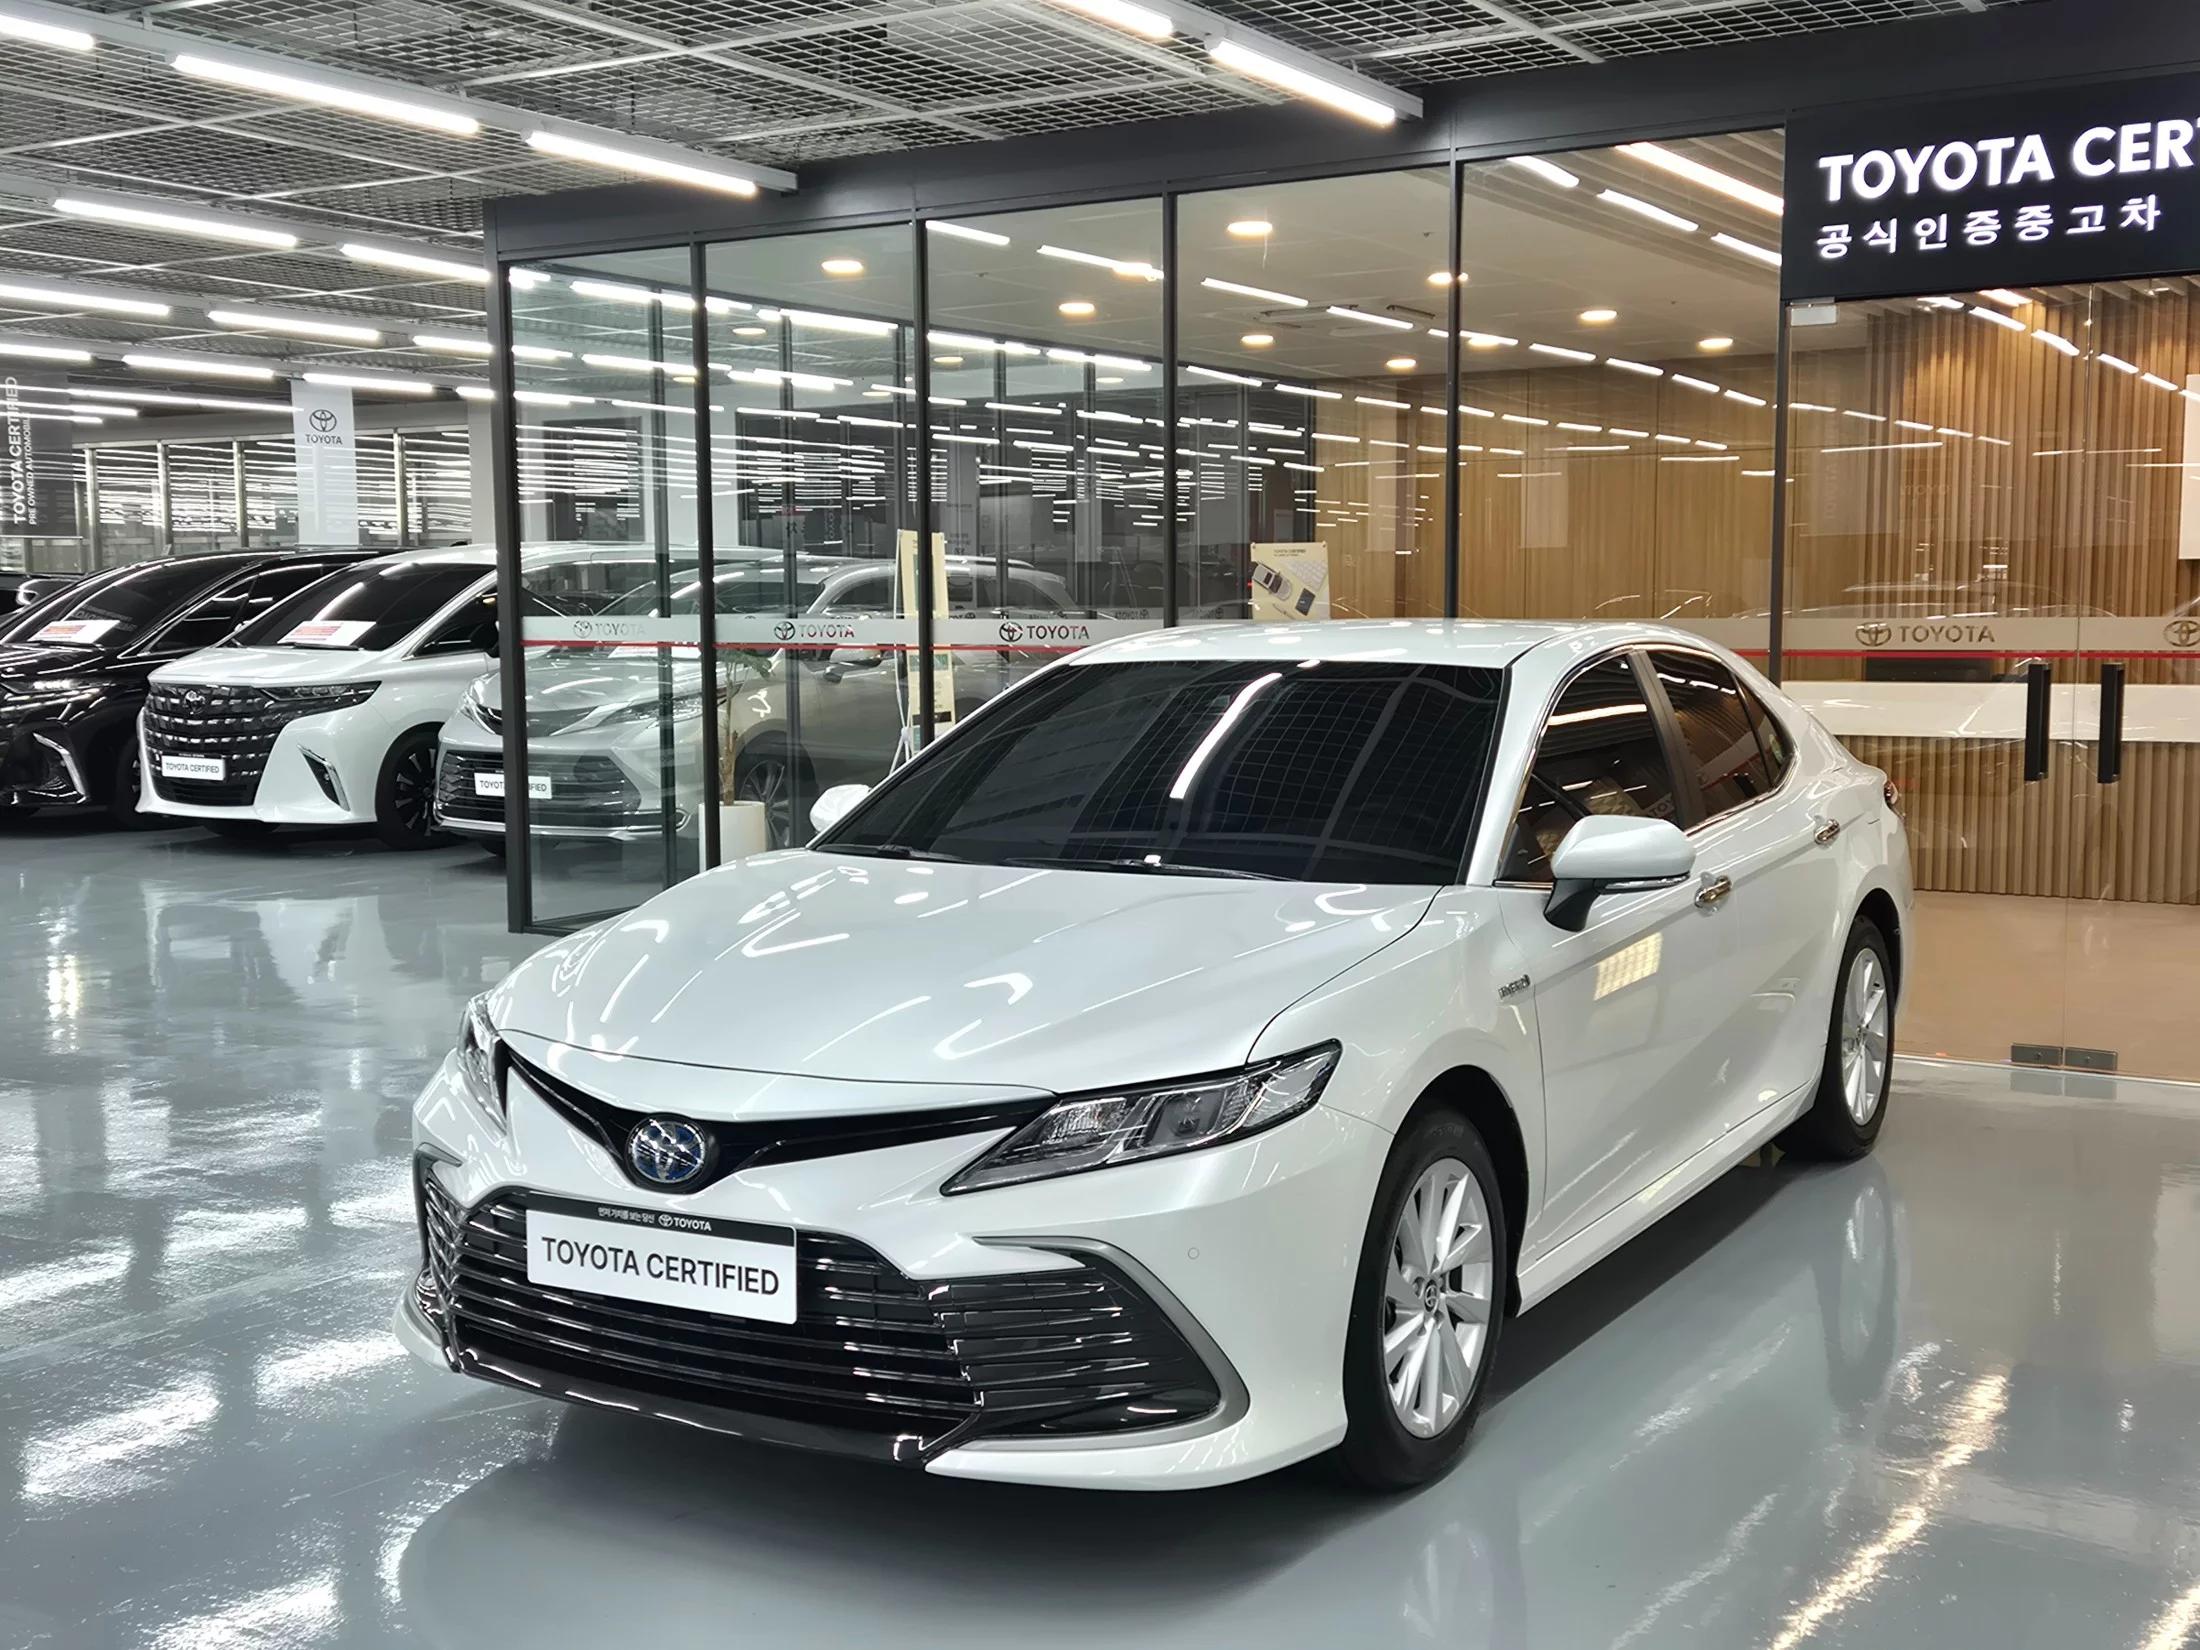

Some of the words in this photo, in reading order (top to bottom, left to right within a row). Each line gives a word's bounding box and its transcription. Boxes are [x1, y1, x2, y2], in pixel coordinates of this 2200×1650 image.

[1818, 134, 2055, 201] TOYOTA
[2072, 116, 2200, 177] CER
[305, 434, 343, 445] TOYOTA
[10, 460, 27, 524] TOYOTA
[595, 623, 646, 636] TOYOTA
[799, 624, 855, 638] TOYOTA
[1026, 625, 1090, 640] TOYOTA
[1898, 625, 1995, 643] TOYOTA
[166, 762, 189, 772] TOYOTA
[189, 764, 220, 774] CERTIFIED
[480, 780, 505, 790] TOYOT
[674, 1217, 712, 1232] TOYOTA
[541, 1236, 640, 1276] TOYOTA
[646, 1252, 779, 1295] CERTIFIED
